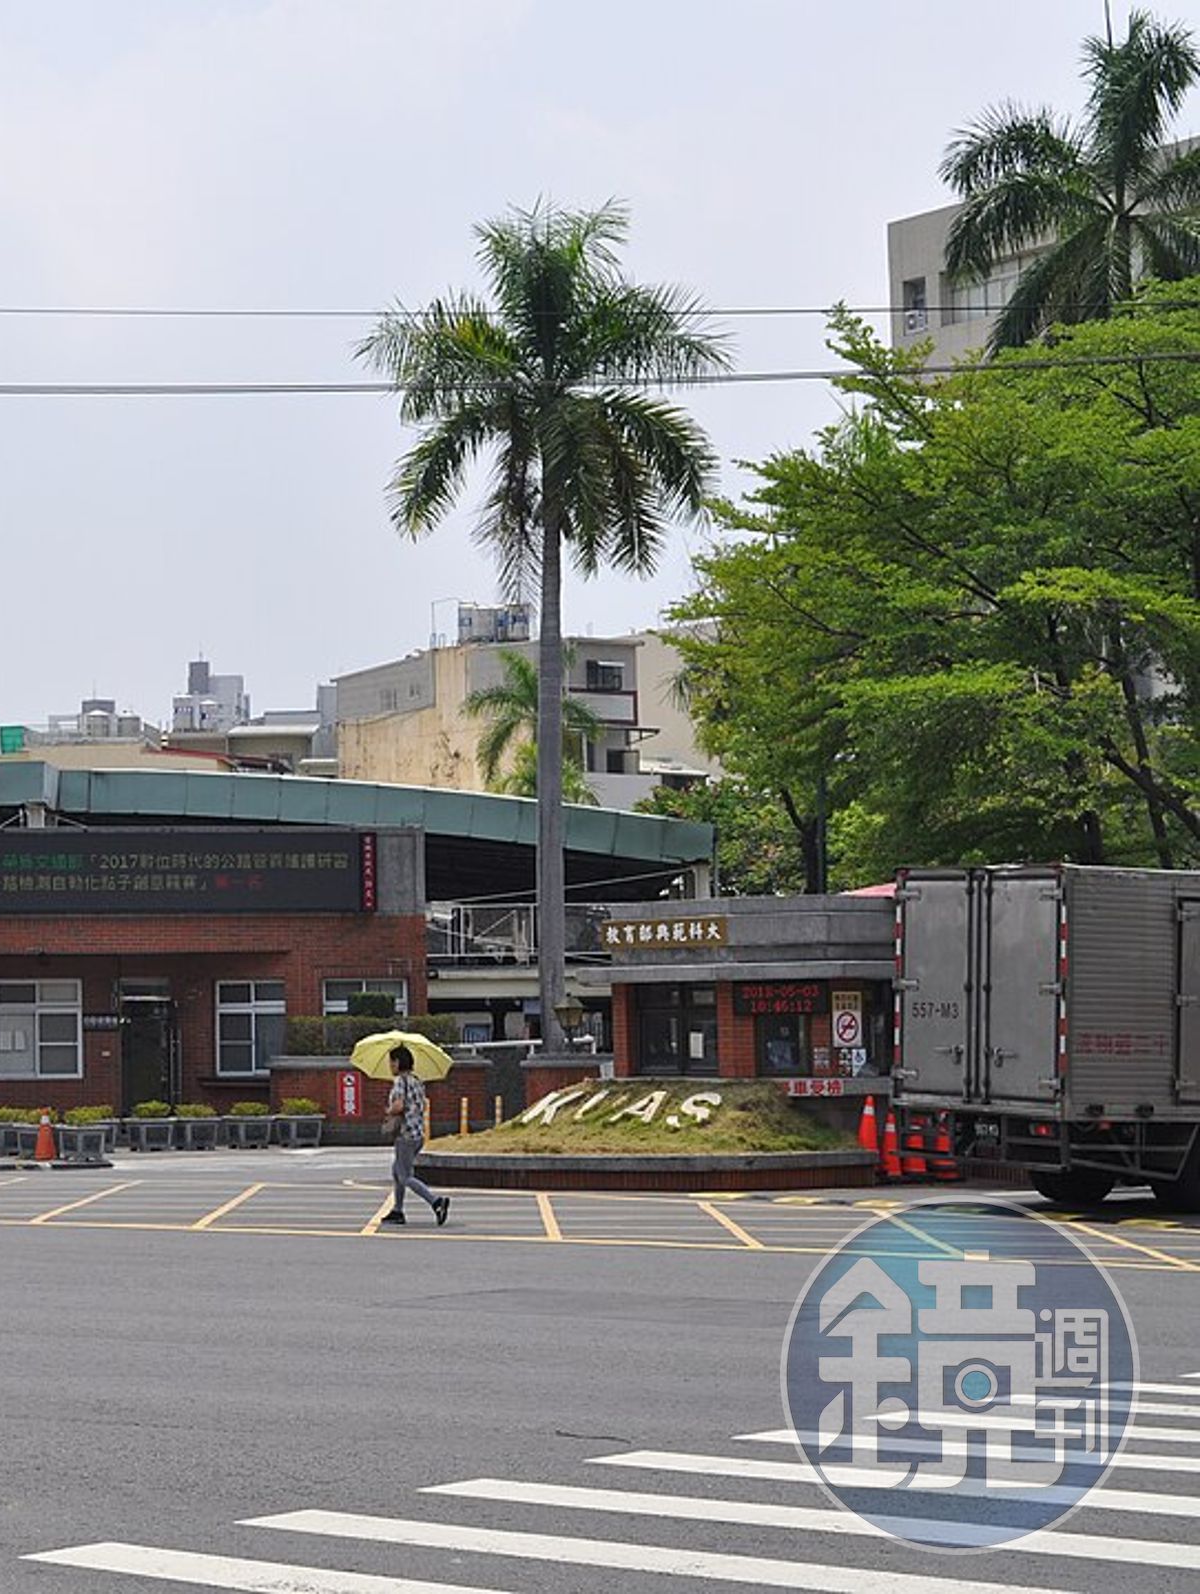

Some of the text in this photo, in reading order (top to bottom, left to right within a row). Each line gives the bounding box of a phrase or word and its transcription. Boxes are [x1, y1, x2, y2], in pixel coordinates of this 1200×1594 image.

[605, 921, 722, 944] 教育部典範科大
[911, 1002, 960, 1019] 557-M3
